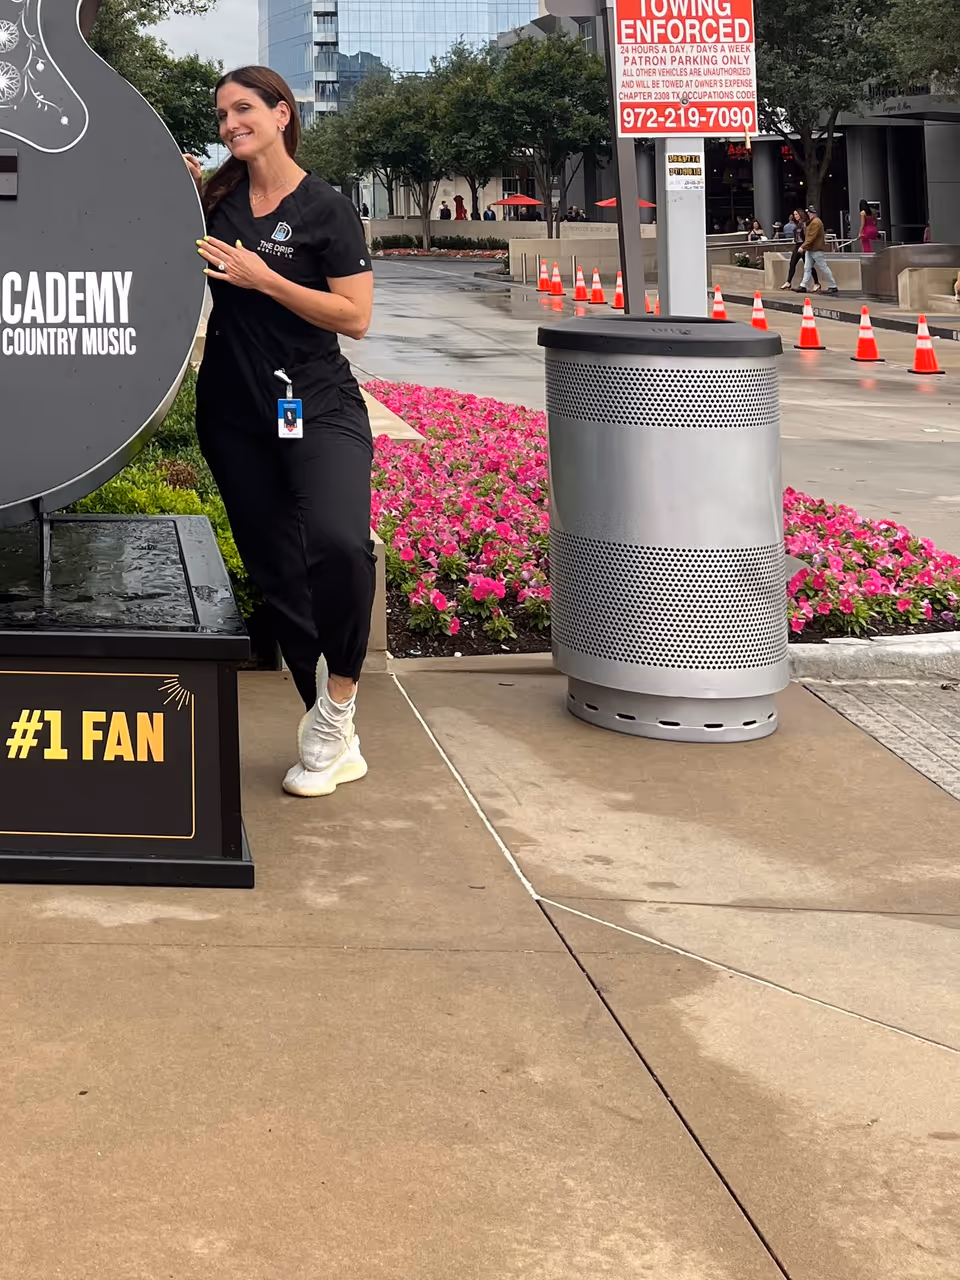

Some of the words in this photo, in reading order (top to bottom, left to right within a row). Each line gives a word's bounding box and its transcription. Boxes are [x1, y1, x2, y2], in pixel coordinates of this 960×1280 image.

[620, 18, 750, 44] ENFORCED
[620, 46, 629, 54] 24
[632, 45, 660, 54] HOURS
[661, 45, 667, 54] A
[690, 45, 695, 53] 7
[696, 45, 718, 53] DAYS
[720, 45, 726, 53] A
[728, 44, 752, 53] WEEK
[623, 55, 667, 66] PATRON
[670, 55, 718, 66] PARKING
[722, 54, 750, 65] ONLY
[622, 68, 634, 77] ALL
[636, 68, 657, 77] OTHER
[658, 68, 688, 77] VEHICLES
[689, 68, 702, 77] ARE
[703, 67, 751, 76] UNAUTHORIZED
[621, 80, 634, 89] AND
[636, 80, 651, 88] WILL
[652, 80, 660, 88] BE
[662, 80, 684, 88] TOWED
[685, 80, 693, 88] AT
[725, 79, 753, 88] EXPENSE
[619, 92, 653, 100] CHAPTER
[654, 92, 670, 100] 2308
[671, 91, 680, 99] TX
[682, 91, 734, 100] OCCUPATIONS
[736, 91, 756, 100] CODE
[622, 106, 753, 128] 972-219-7090
[260, 240, 274, 250] THE
[274, 244, 294, 254] DRIP
[2, 327, 78, 356] COUNTRY
[82, 326, 137, 356] MUSIC
[6, 708, 68, 761] #1
[81, 710, 165, 762] FAN
